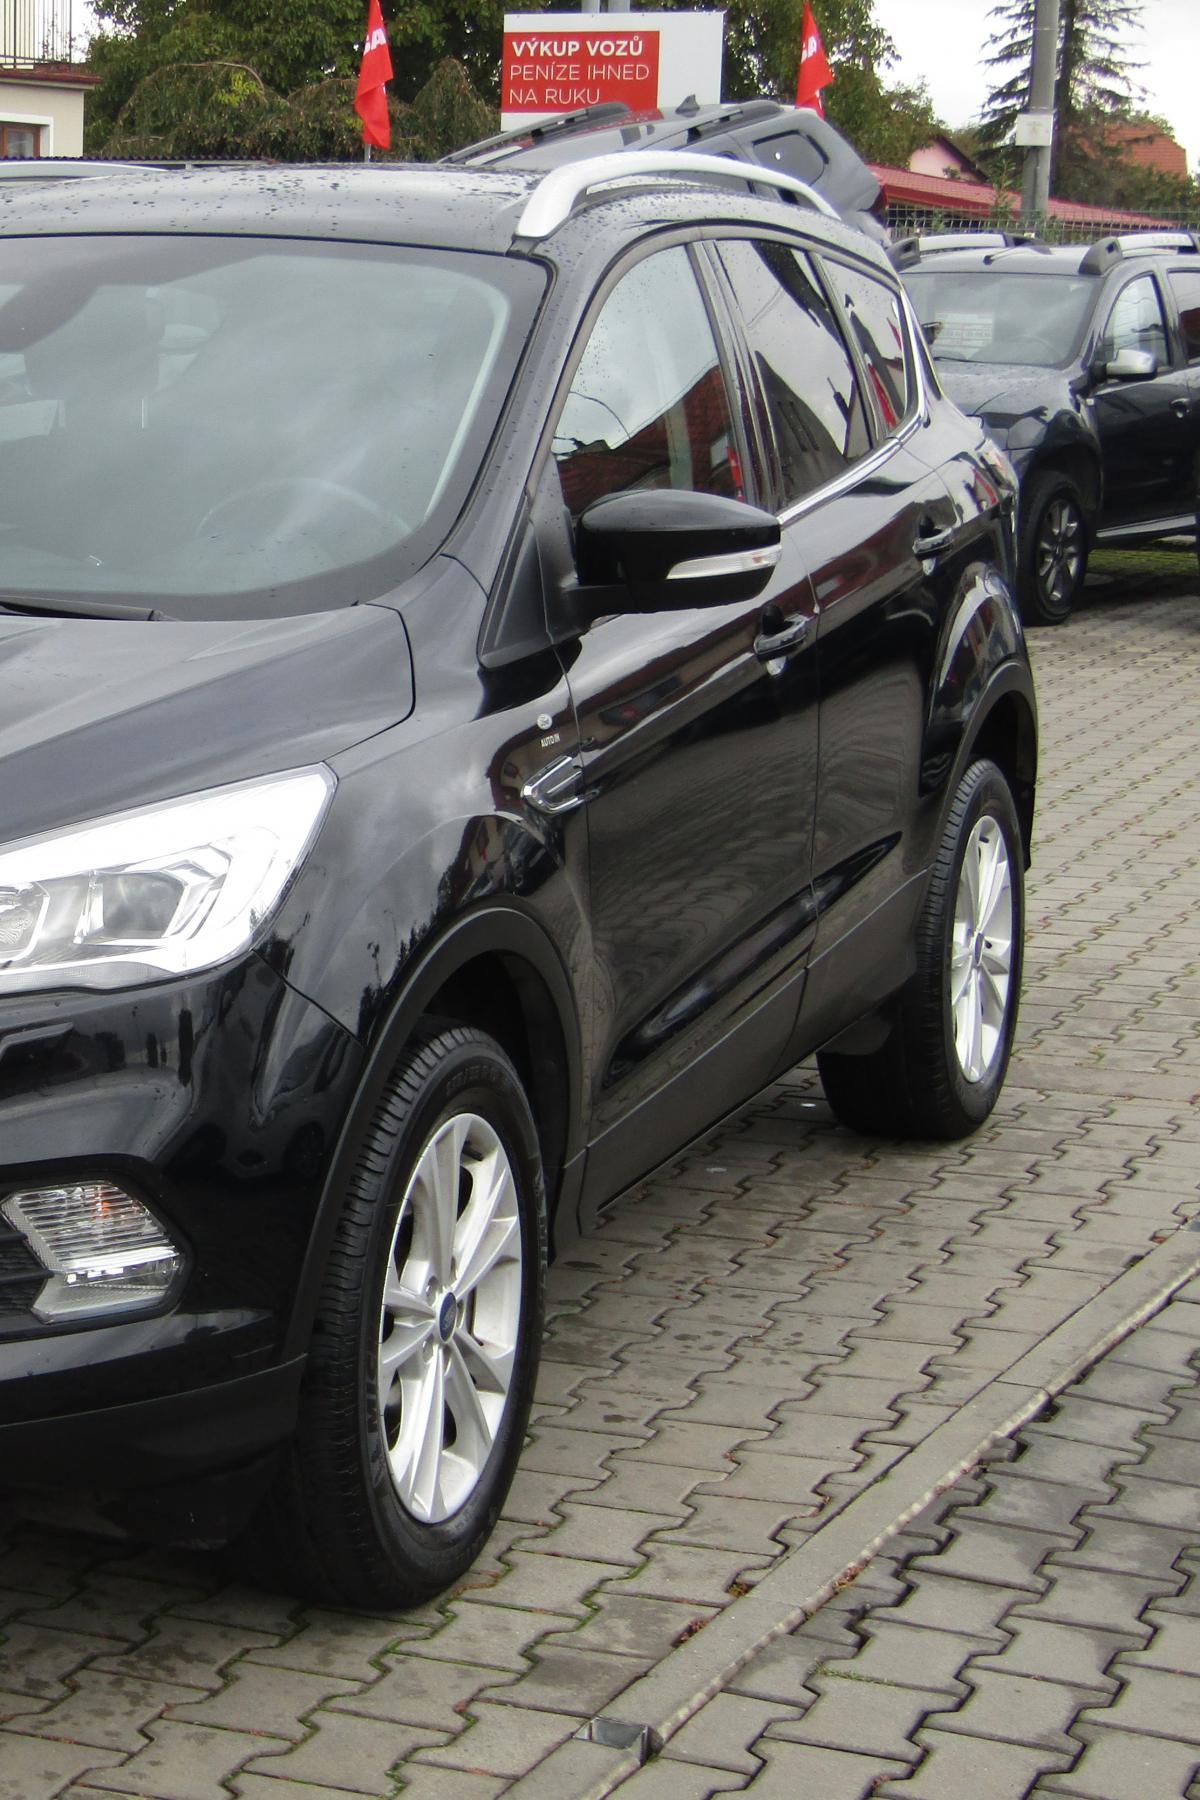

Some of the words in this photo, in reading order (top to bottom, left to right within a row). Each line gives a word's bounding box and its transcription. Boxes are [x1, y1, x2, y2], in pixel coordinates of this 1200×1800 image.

[512, 37, 580, 57] VÝKUP
[586, 35, 643, 57] VOZŮ
[510, 61, 580, 81] PENÍZE
[587, 64, 650, 80] IHNED
[509, 89, 538, 105] NA
[545, 88, 600, 105] RUKU
